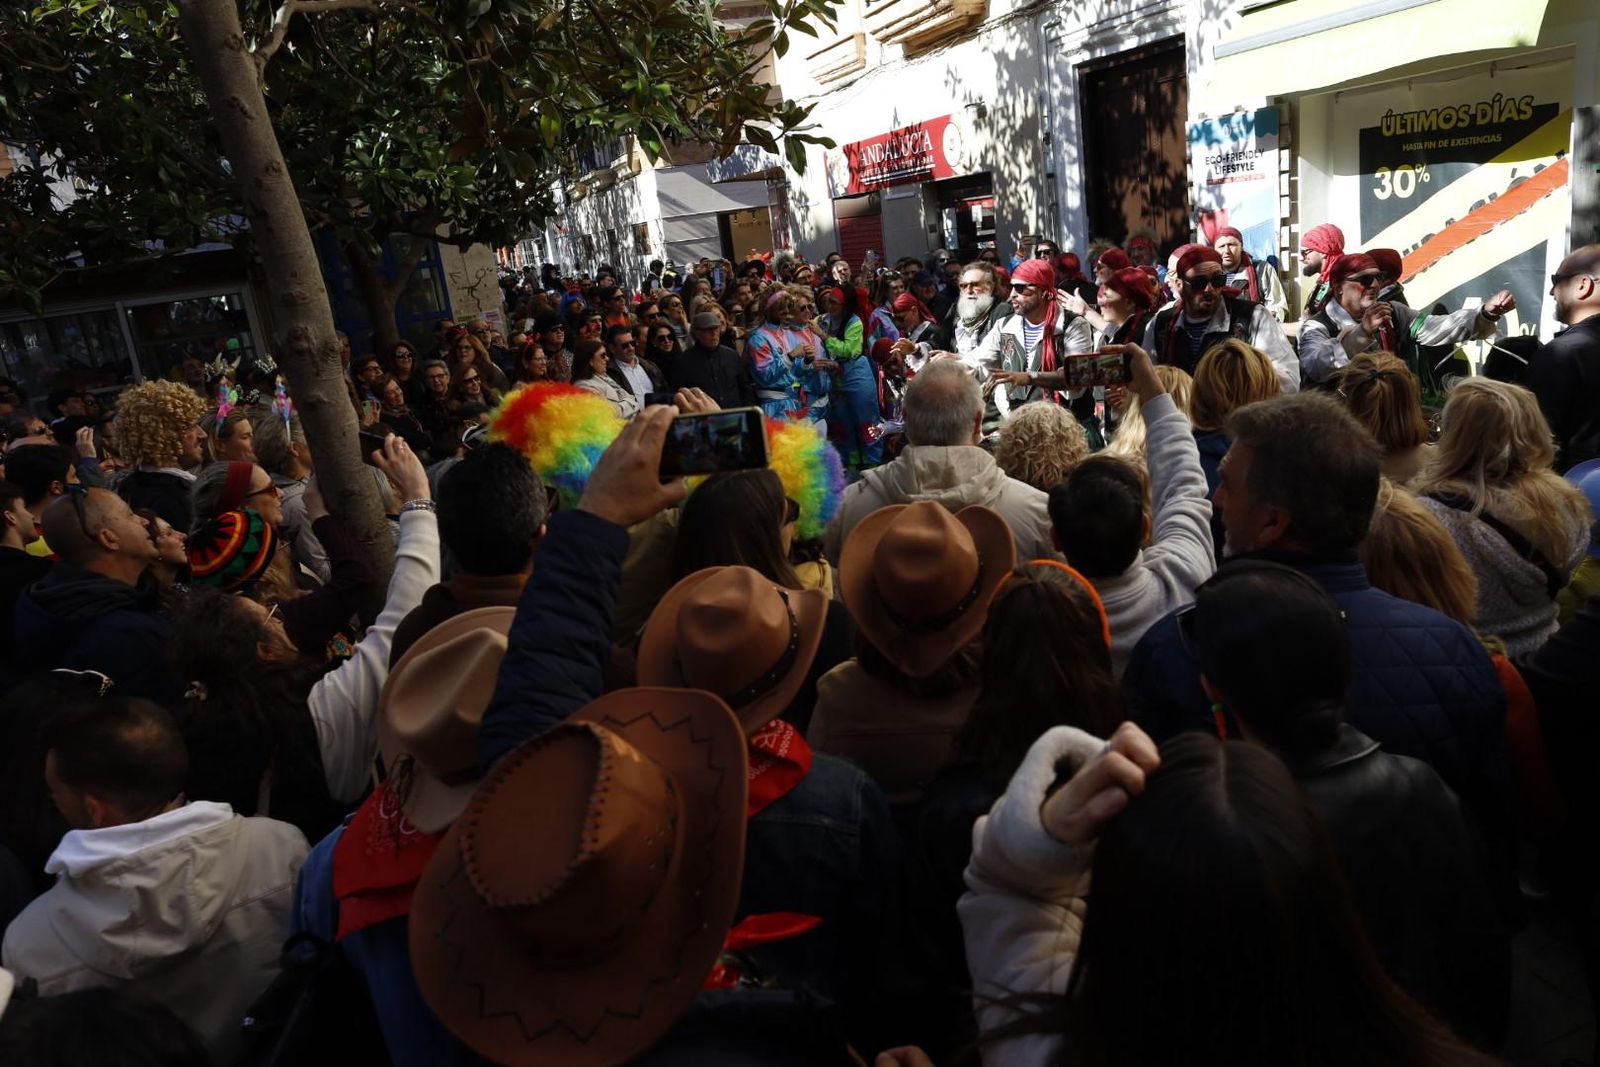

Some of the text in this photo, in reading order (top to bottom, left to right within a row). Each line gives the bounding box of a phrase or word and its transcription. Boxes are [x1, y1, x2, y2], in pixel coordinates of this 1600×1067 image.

[1381, 93, 1534, 137] ÚLTIMOS DÍAS
[1402, 134, 1502, 151] HASTA FIN DE EXISTENCIAS
[1205, 149, 1264, 165] ECO-FRIENDLY
[1215, 162, 1255, 174] LIFESTYLE
[1373, 163, 1431, 200] 30%
